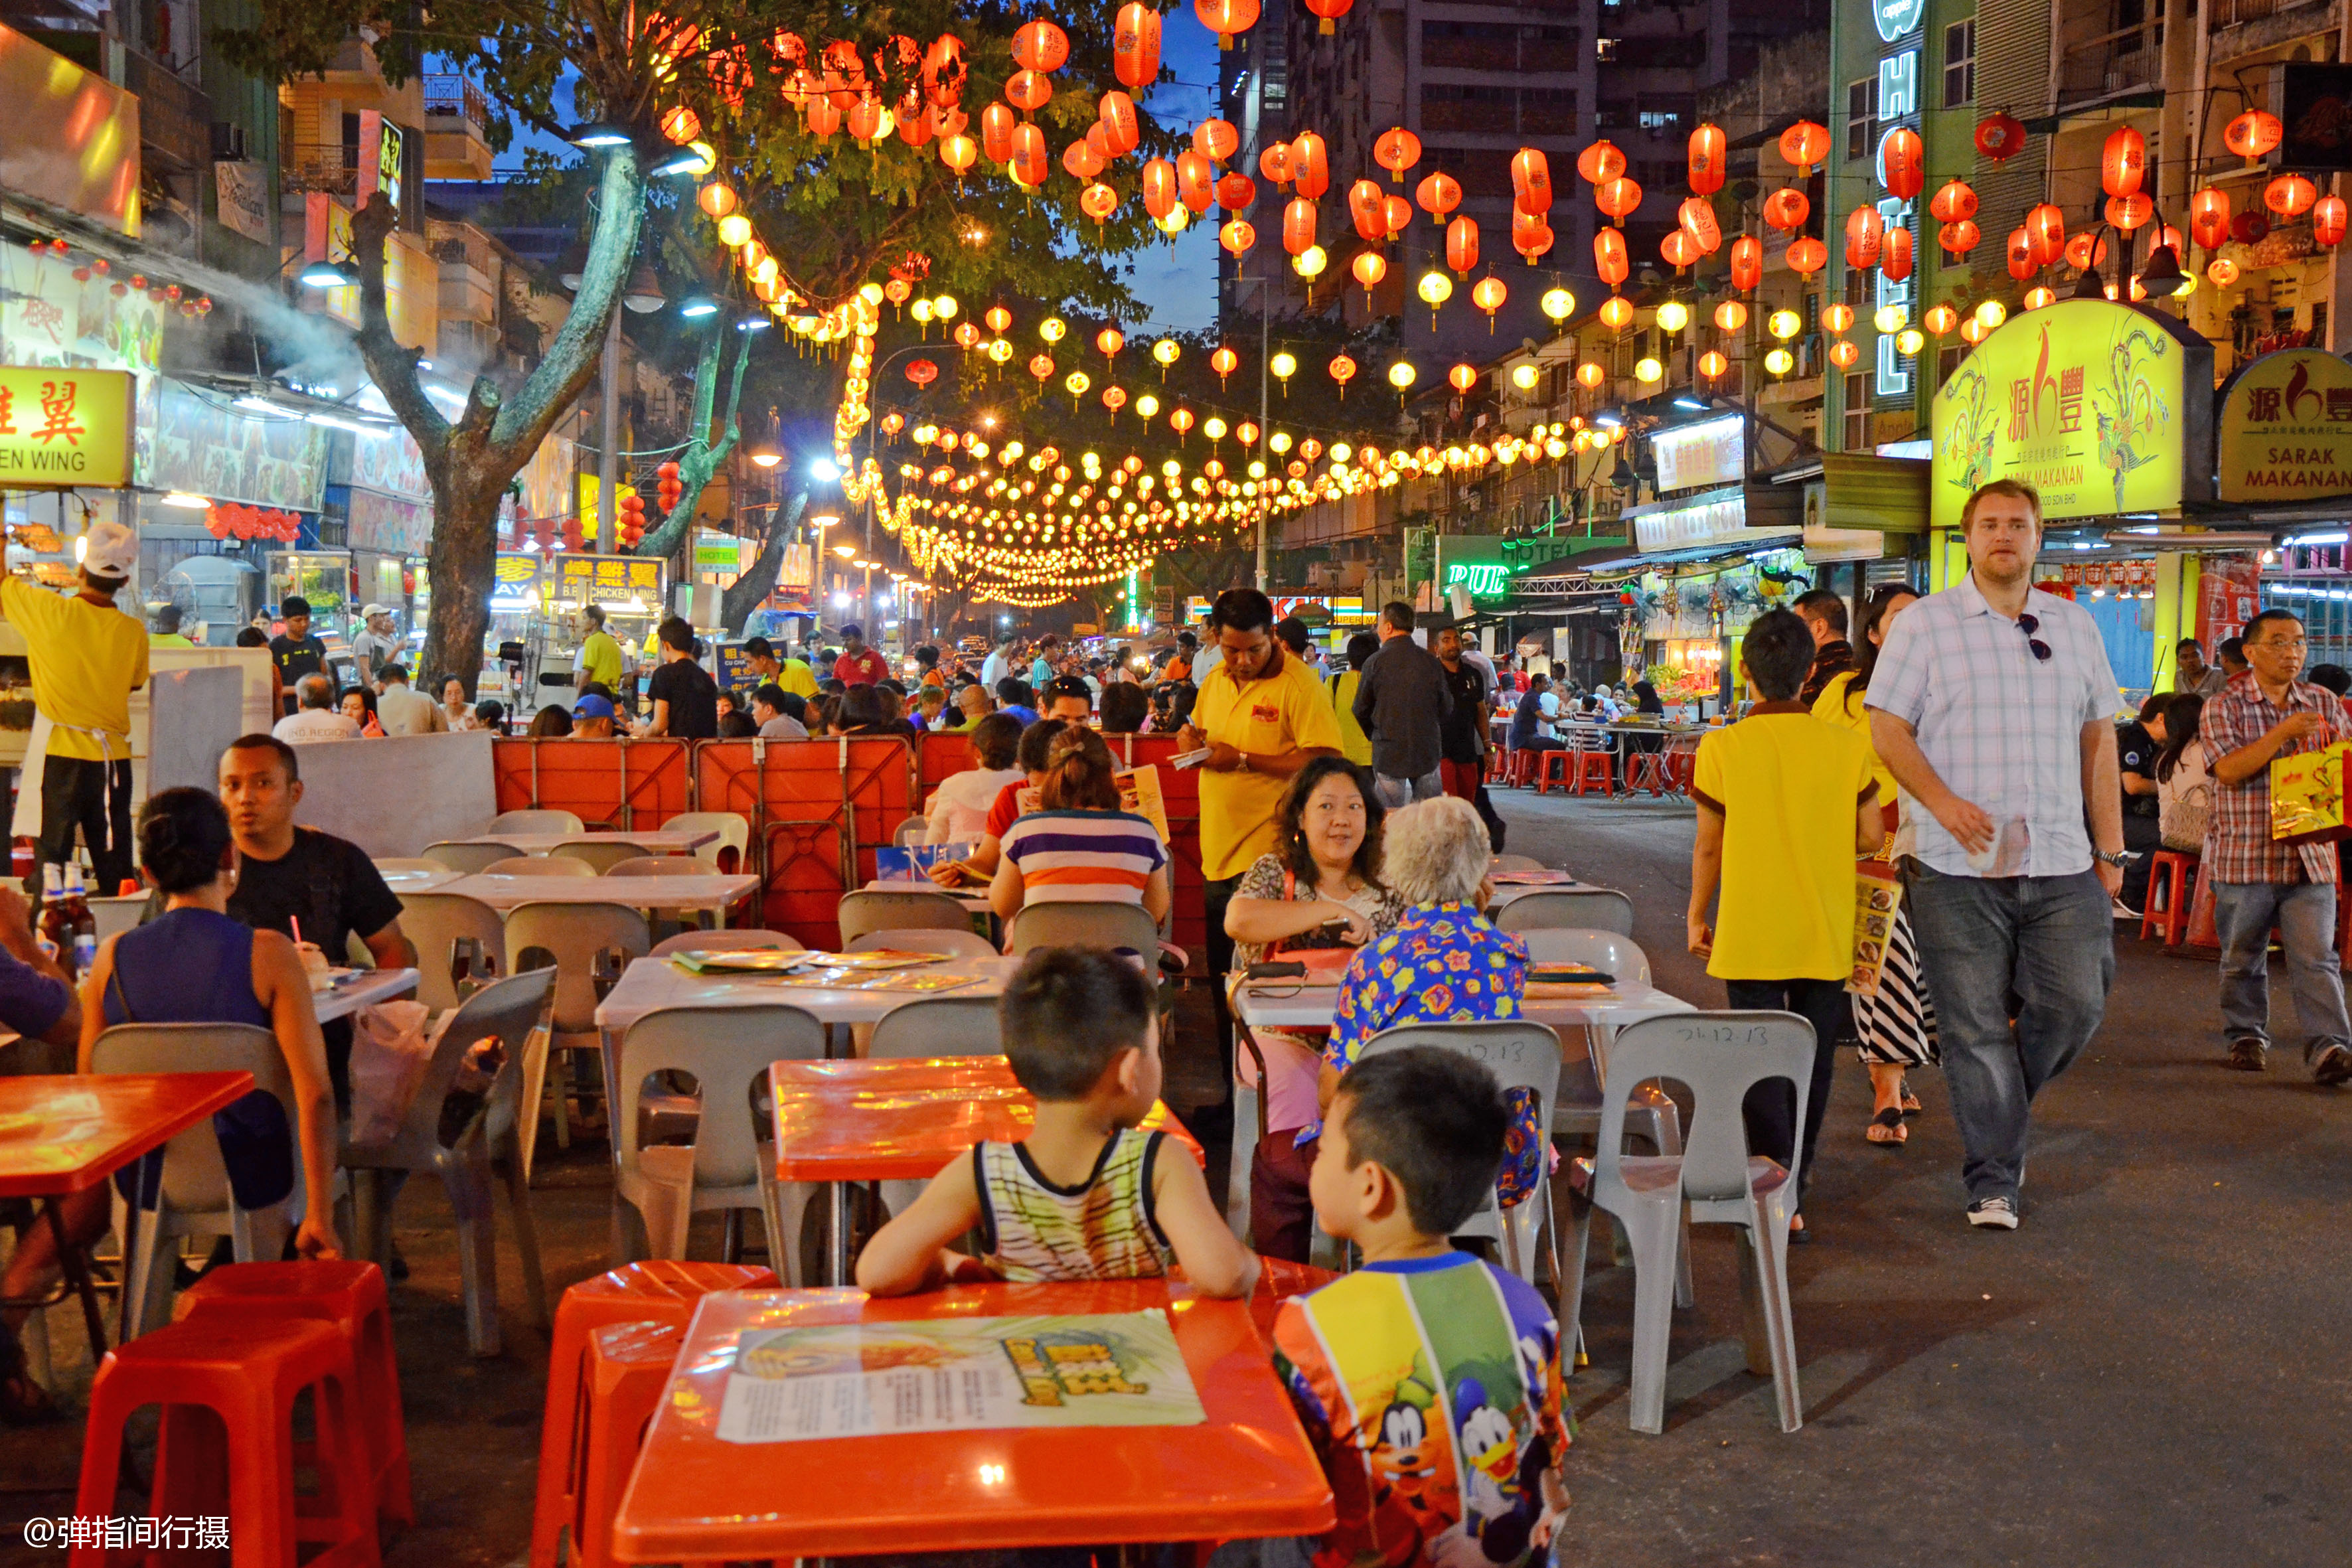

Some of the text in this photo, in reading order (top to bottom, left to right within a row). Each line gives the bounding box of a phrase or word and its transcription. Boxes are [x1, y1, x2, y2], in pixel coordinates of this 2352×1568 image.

[31, 451, 86, 472] WING
[2268, 447, 2335, 465] SARAK
[2034, 465, 2084, 489] MAKANAN
[2245, 470, 2352, 487] MAKANAN
[591, 587, 630, 599] CHICKEN
